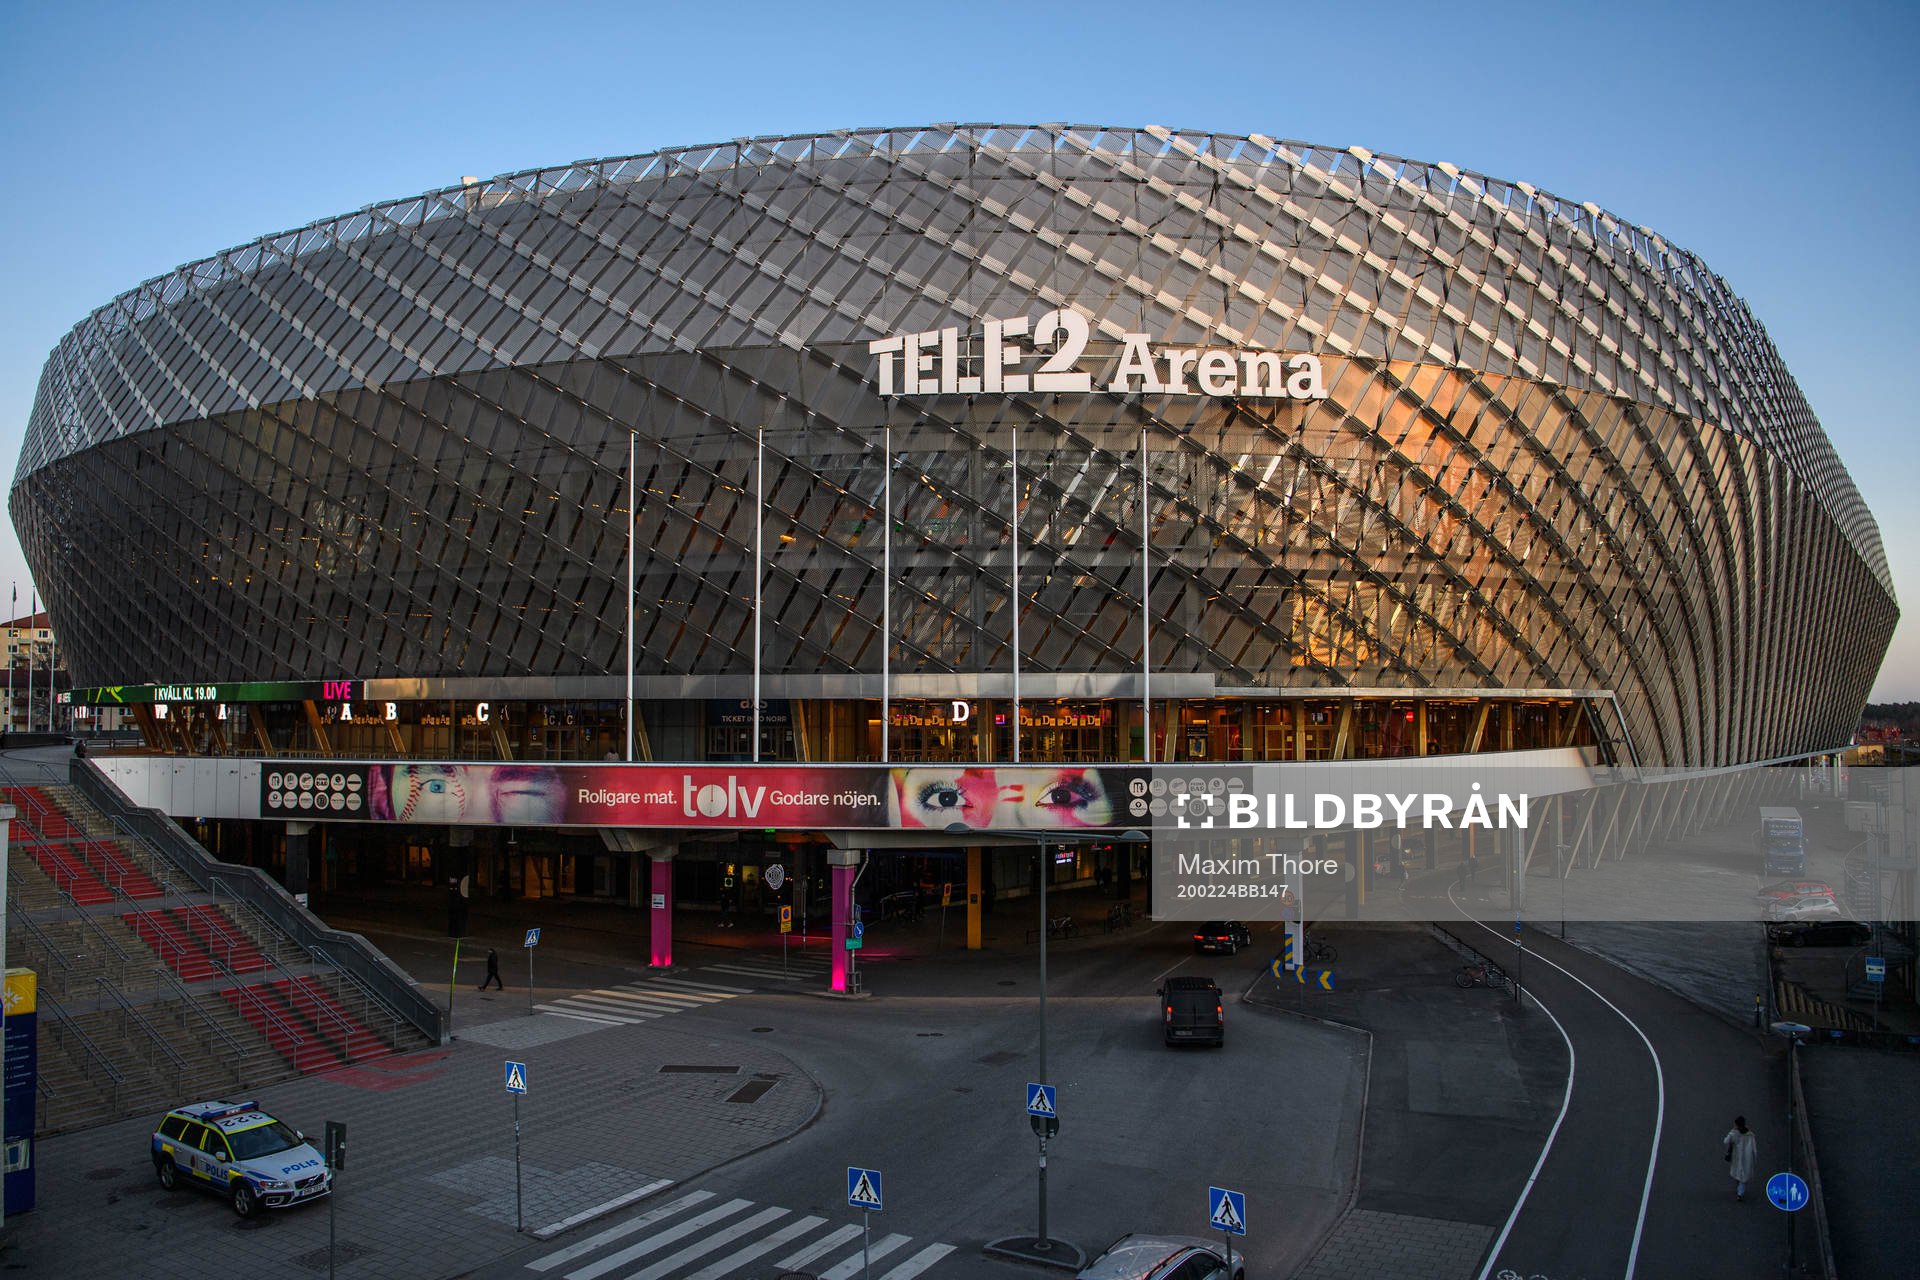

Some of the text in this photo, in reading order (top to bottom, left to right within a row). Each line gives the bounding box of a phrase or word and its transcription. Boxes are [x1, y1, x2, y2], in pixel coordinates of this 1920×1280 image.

[869, 309, 1328, 400] TELE2 Arena
[158, 686, 182, 700] KVÄLL
[182, 687, 194, 700] KL
[195, 686, 217, 700] 19.00
[323, 682, 352, 700] LIVE
[340, 703, 353, 721] A
[385, 702, 398, 720] B
[476, 702, 489, 721] C
[952, 701, 970, 722] D
[578, 788, 677, 807] Roligare mat.
[683, 774, 767, 819] tolv
[770, 789, 881, 808] Godare nöjen.
[205, 1163, 228, 1180] POLIS
[281, 1159, 320, 1175] POLIS
